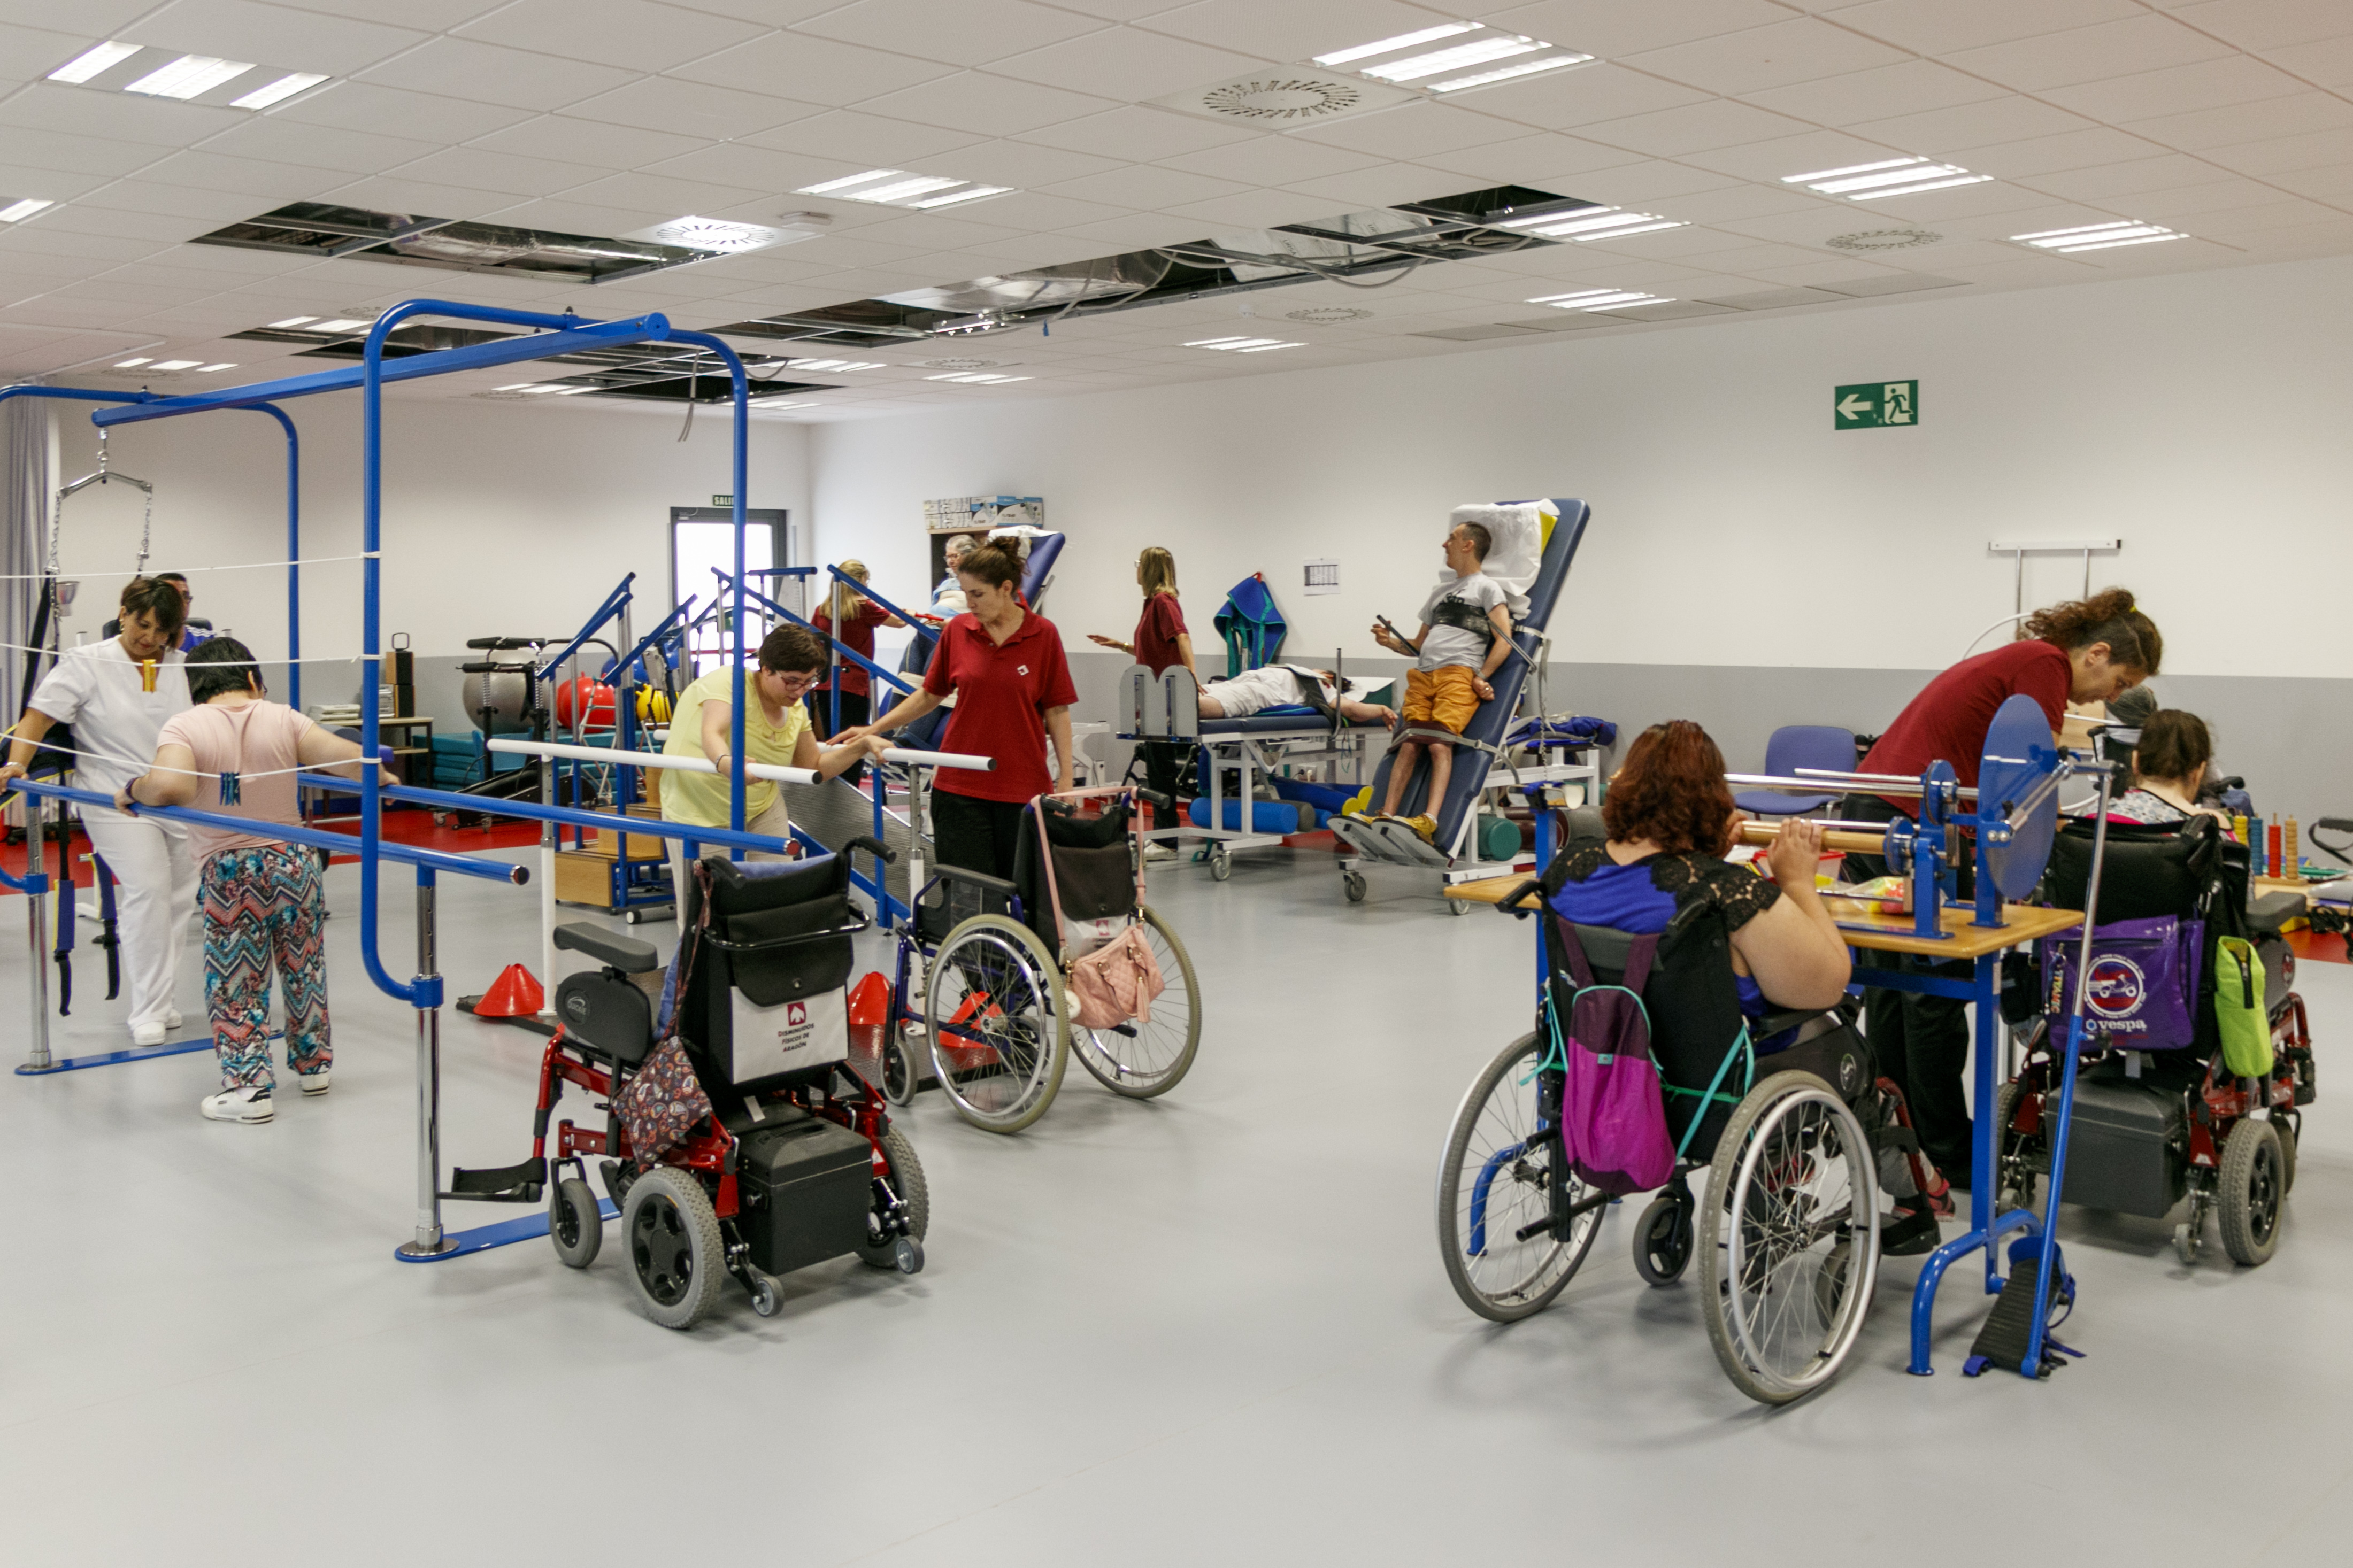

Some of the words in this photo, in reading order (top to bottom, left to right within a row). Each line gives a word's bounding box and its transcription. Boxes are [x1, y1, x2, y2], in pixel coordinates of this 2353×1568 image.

[714, 496, 734, 505] SALI
[2050, 969, 2064, 1014] TITANIC
[778, 1023, 814, 1037] DISMINUIDOS
[2097, 1019, 2147, 1032] vespa
